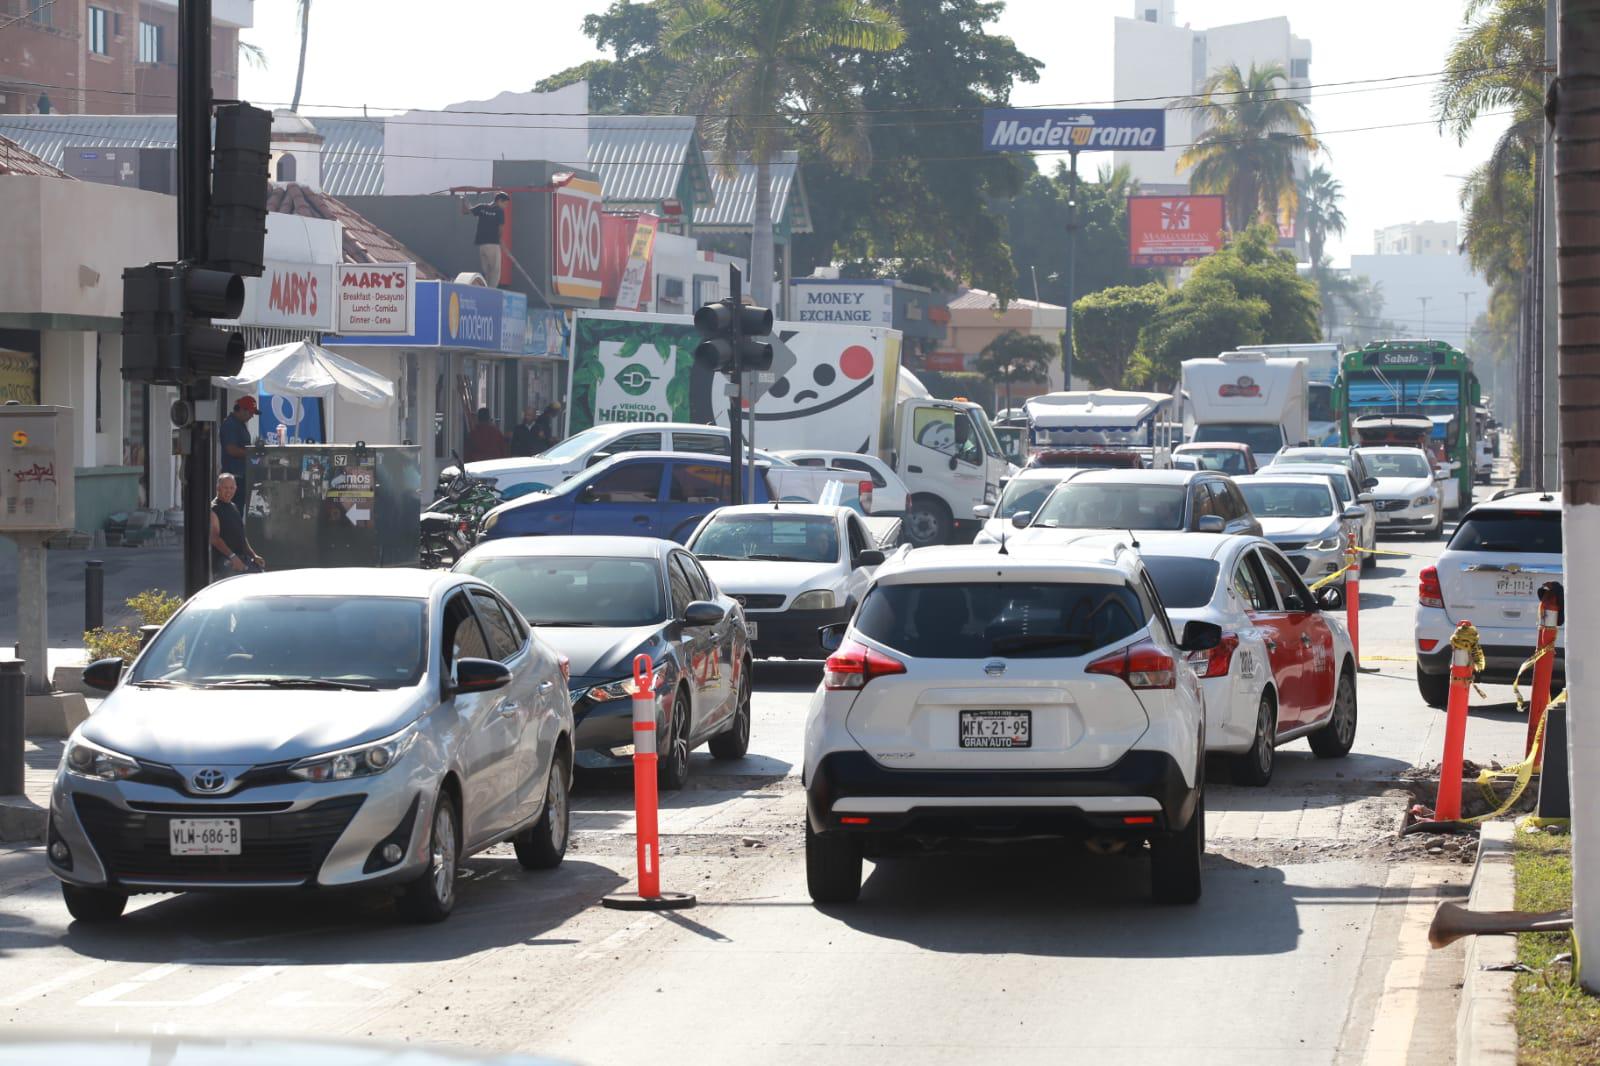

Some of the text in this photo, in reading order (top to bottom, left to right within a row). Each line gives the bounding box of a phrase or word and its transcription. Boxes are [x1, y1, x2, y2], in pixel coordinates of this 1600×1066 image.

[560, 200, 601, 277] OXXO
[342, 271, 406, 289] MARY'S
[269, 271, 318, 317] MARY'S
[343, 291, 371, 301] Breakfast
[375, 292, 405, 303] Desayuno
[807, 292, 864, 305] MONEY
[352, 303, 371, 313] Lunch
[374, 304, 398, 313] Comida
[349, 315, 371, 325] Dinner
[374, 315, 391, 325] Cena
[800, 310, 871, 321] EXCHANGE
[598, 404, 668, 423] HÍBRIDO
[620, 403, 656, 411] VEHÍCULO
[962, 721, 1028, 735] WFK-21-95
[964, 738, 1012, 747] GRAN AUTO
[173, 828, 238, 844] VLW-686-B
